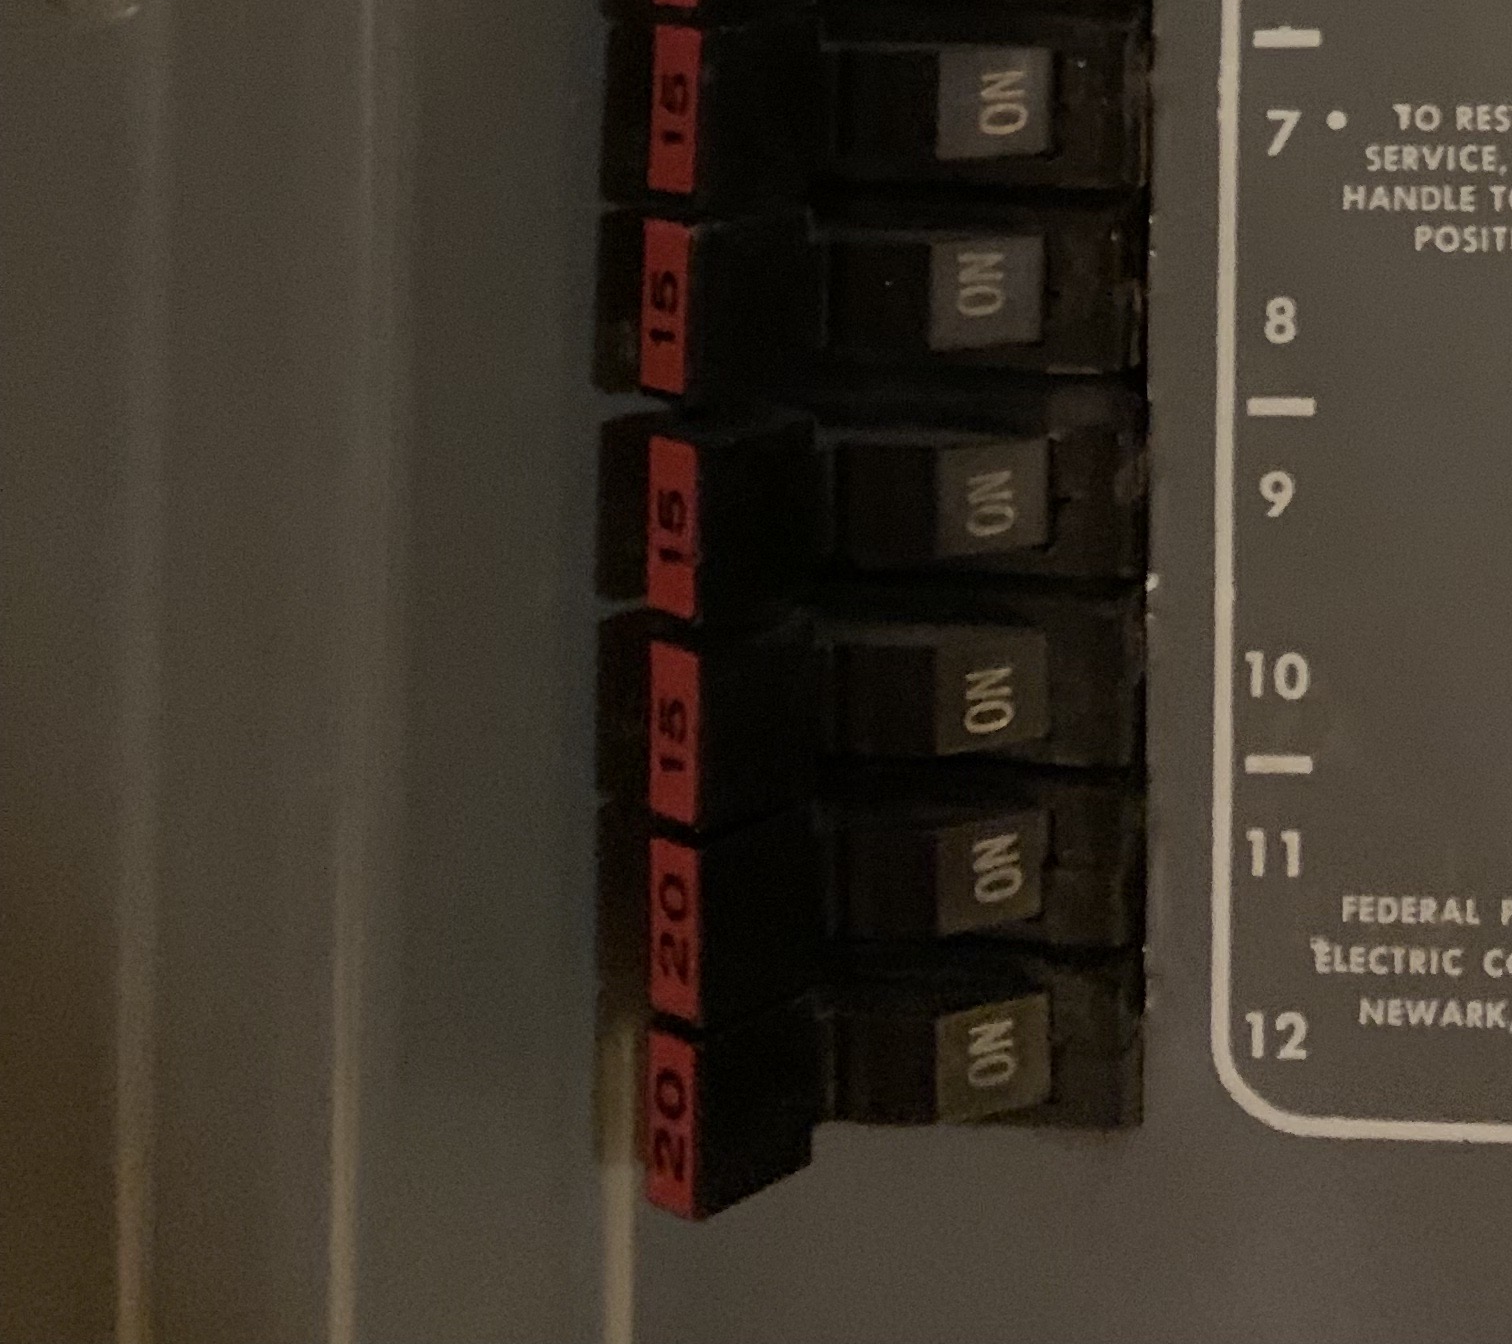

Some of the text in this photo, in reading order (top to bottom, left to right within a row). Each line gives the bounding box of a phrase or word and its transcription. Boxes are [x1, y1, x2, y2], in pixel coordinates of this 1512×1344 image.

[661, 72, 691, 145] 15
[978, 70, 1028, 135] ON
[1267, 110, 1300, 156] 7
[1393, 104, 1442, 132] TO
[1343, 186, 1476, 211] HANDLE
[648, 270, 679, 345] 15
[956, 252, 1004, 315] ON
[1263, 296, 1297, 344] 8
[966, 470, 1015, 537] ON
[1259, 470, 1294, 517] 9
[657, 490, 689, 563] 15
[963, 666, 1016, 735] ON
[1246, 651, 1310, 700] 10
[660, 698, 687, 773] 15
[972, 832, 1023, 904] ON
[1246, 828, 1300, 877] 11
[657, 874, 690, 983] 20
[1341, 895, 1480, 926] FEDERAL
[1311, 937, 1463, 977] ELECTRIC
[967, 1018, 1016, 1088] ON
[1246, 1011, 1308, 1060] 12
[654, 1069, 685, 1182] 20
